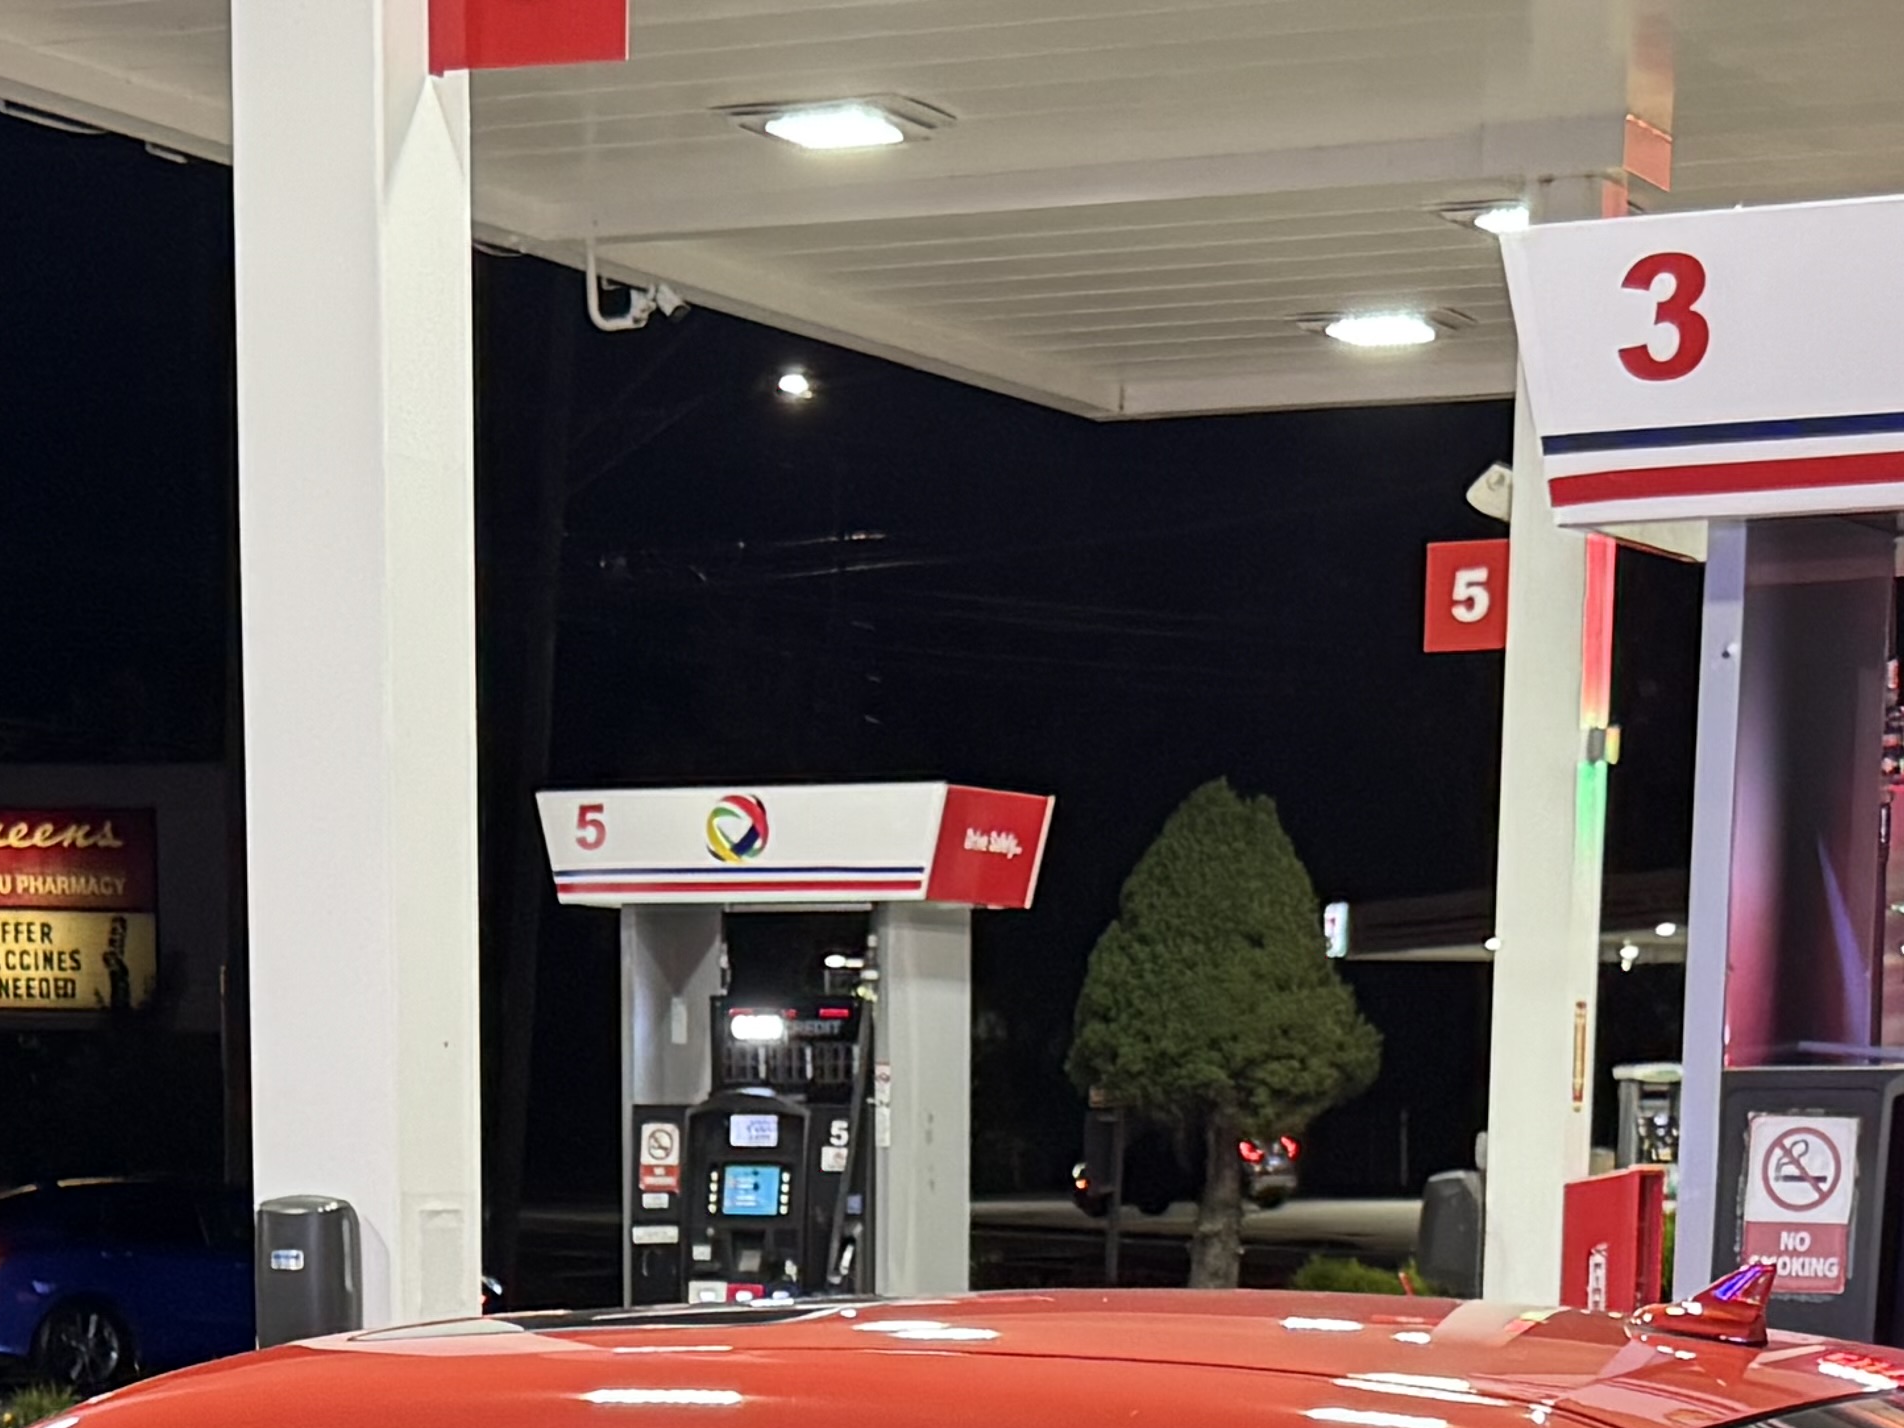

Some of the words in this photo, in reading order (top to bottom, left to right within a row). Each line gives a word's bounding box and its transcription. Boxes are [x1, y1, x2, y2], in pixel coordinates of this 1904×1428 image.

[1619, 252, 1710, 381] 3
[1451, 567, 1491, 623] 5
[576, 804, 607, 850] 5
[15, 873, 127, 896] PHARMACY
[830, 1119, 850, 1146] 5
[1780, 1231, 1812, 1252] NO
